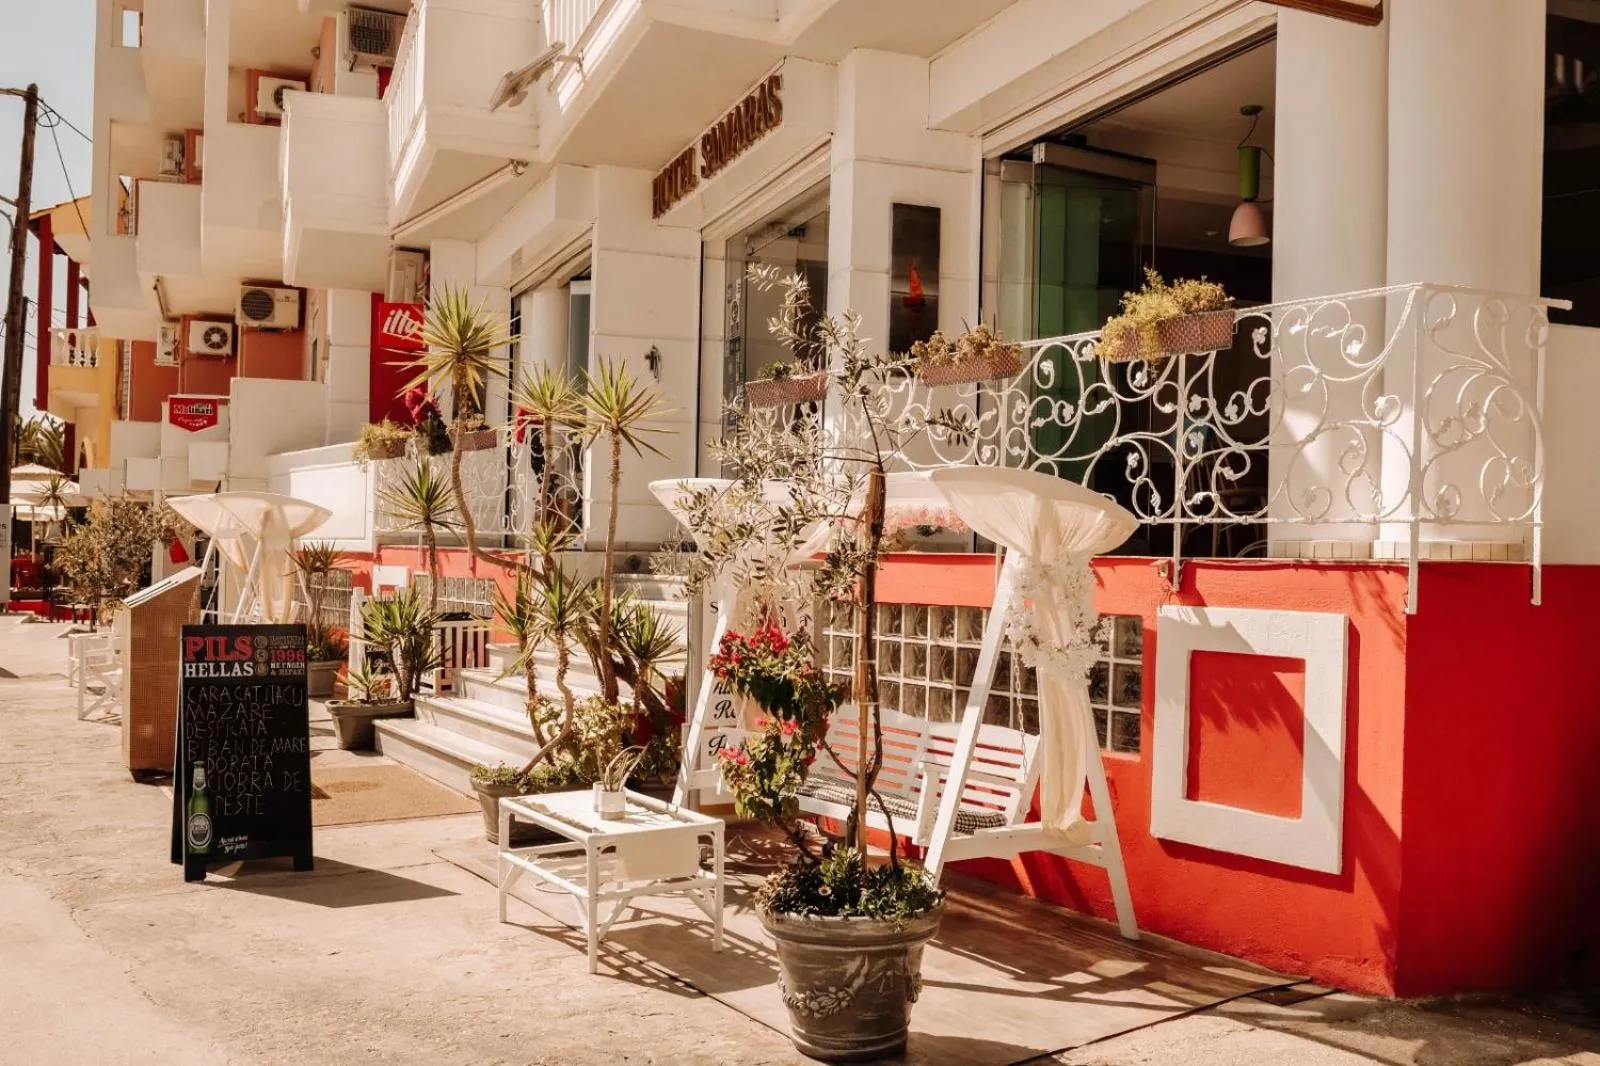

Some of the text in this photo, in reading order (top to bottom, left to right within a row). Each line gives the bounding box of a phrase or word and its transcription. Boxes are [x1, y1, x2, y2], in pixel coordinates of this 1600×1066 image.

[652, 147, 699, 219] HOTEL
[184, 636, 253, 661] PILS
[184, 662, 254, 678] HELLAS
[186, 702, 273, 721] MAZARE
[283, 769, 304, 792] DE
